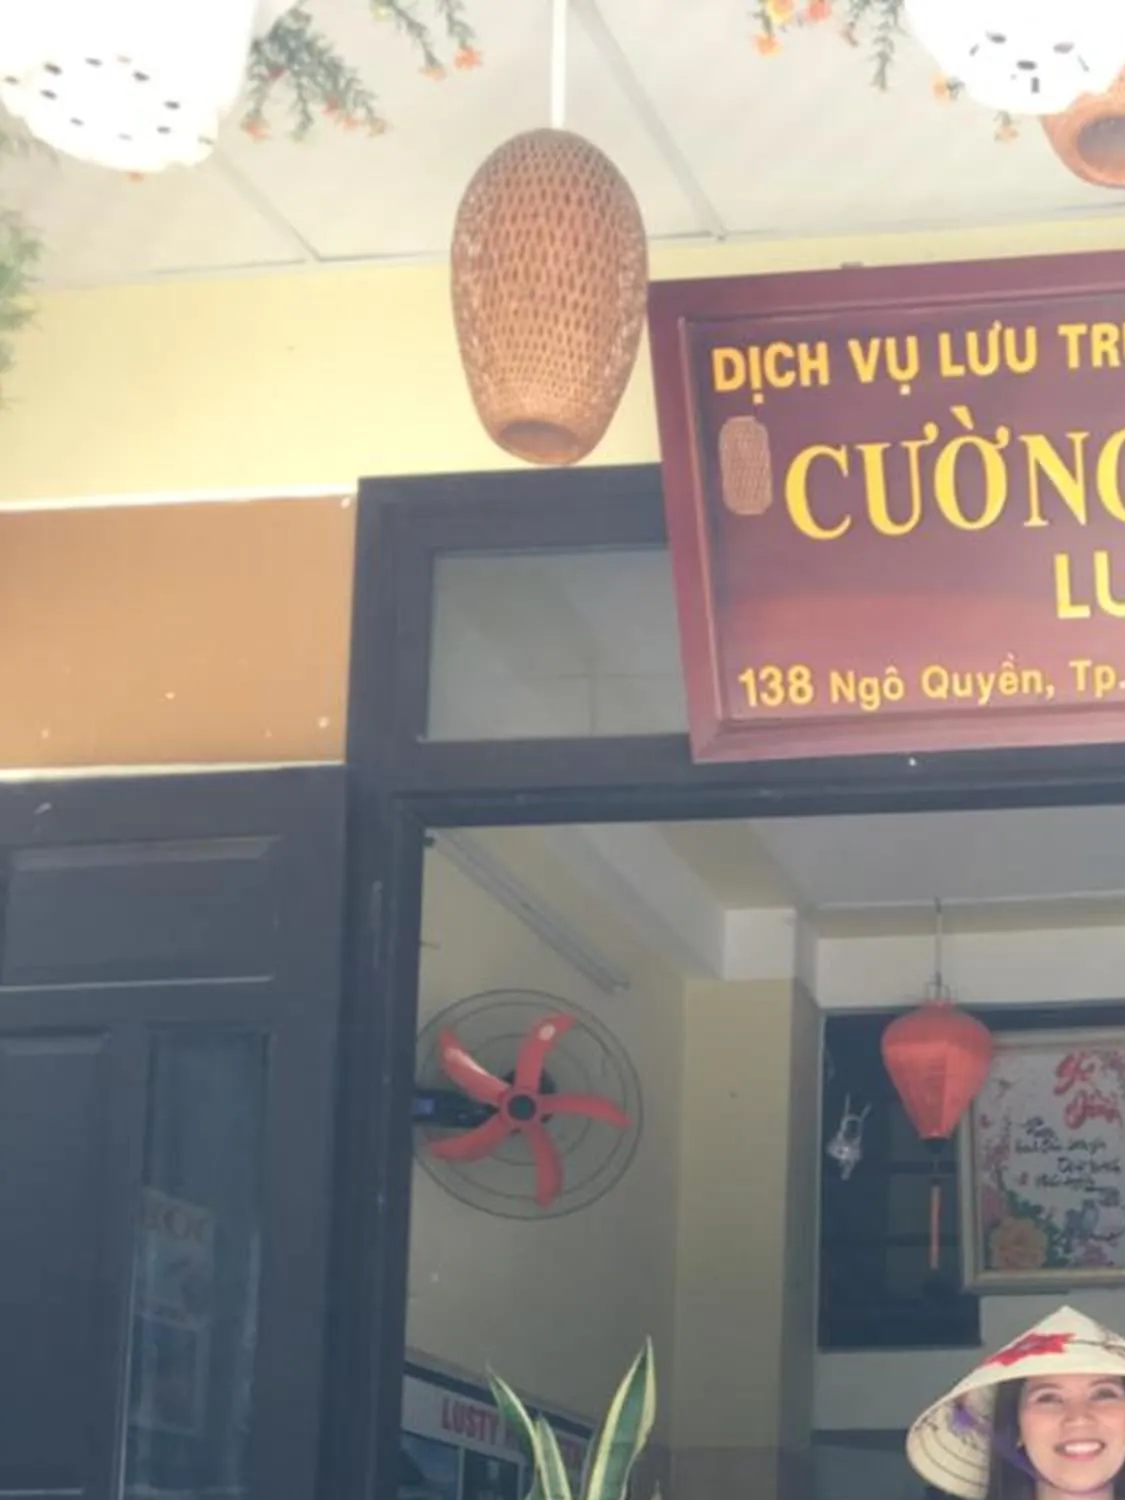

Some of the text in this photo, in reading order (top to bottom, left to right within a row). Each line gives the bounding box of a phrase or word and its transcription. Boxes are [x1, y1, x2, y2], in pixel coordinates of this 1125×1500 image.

[713, 341, 830, 404] DỊCH
[848, 335, 919, 395] VỤ
[939, 319, 1037, 377] LƯU
[738, 664, 814, 707] 138
[829, 667, 904, 711] Ngô
[921, 652, 1056, 706] Quyền,
